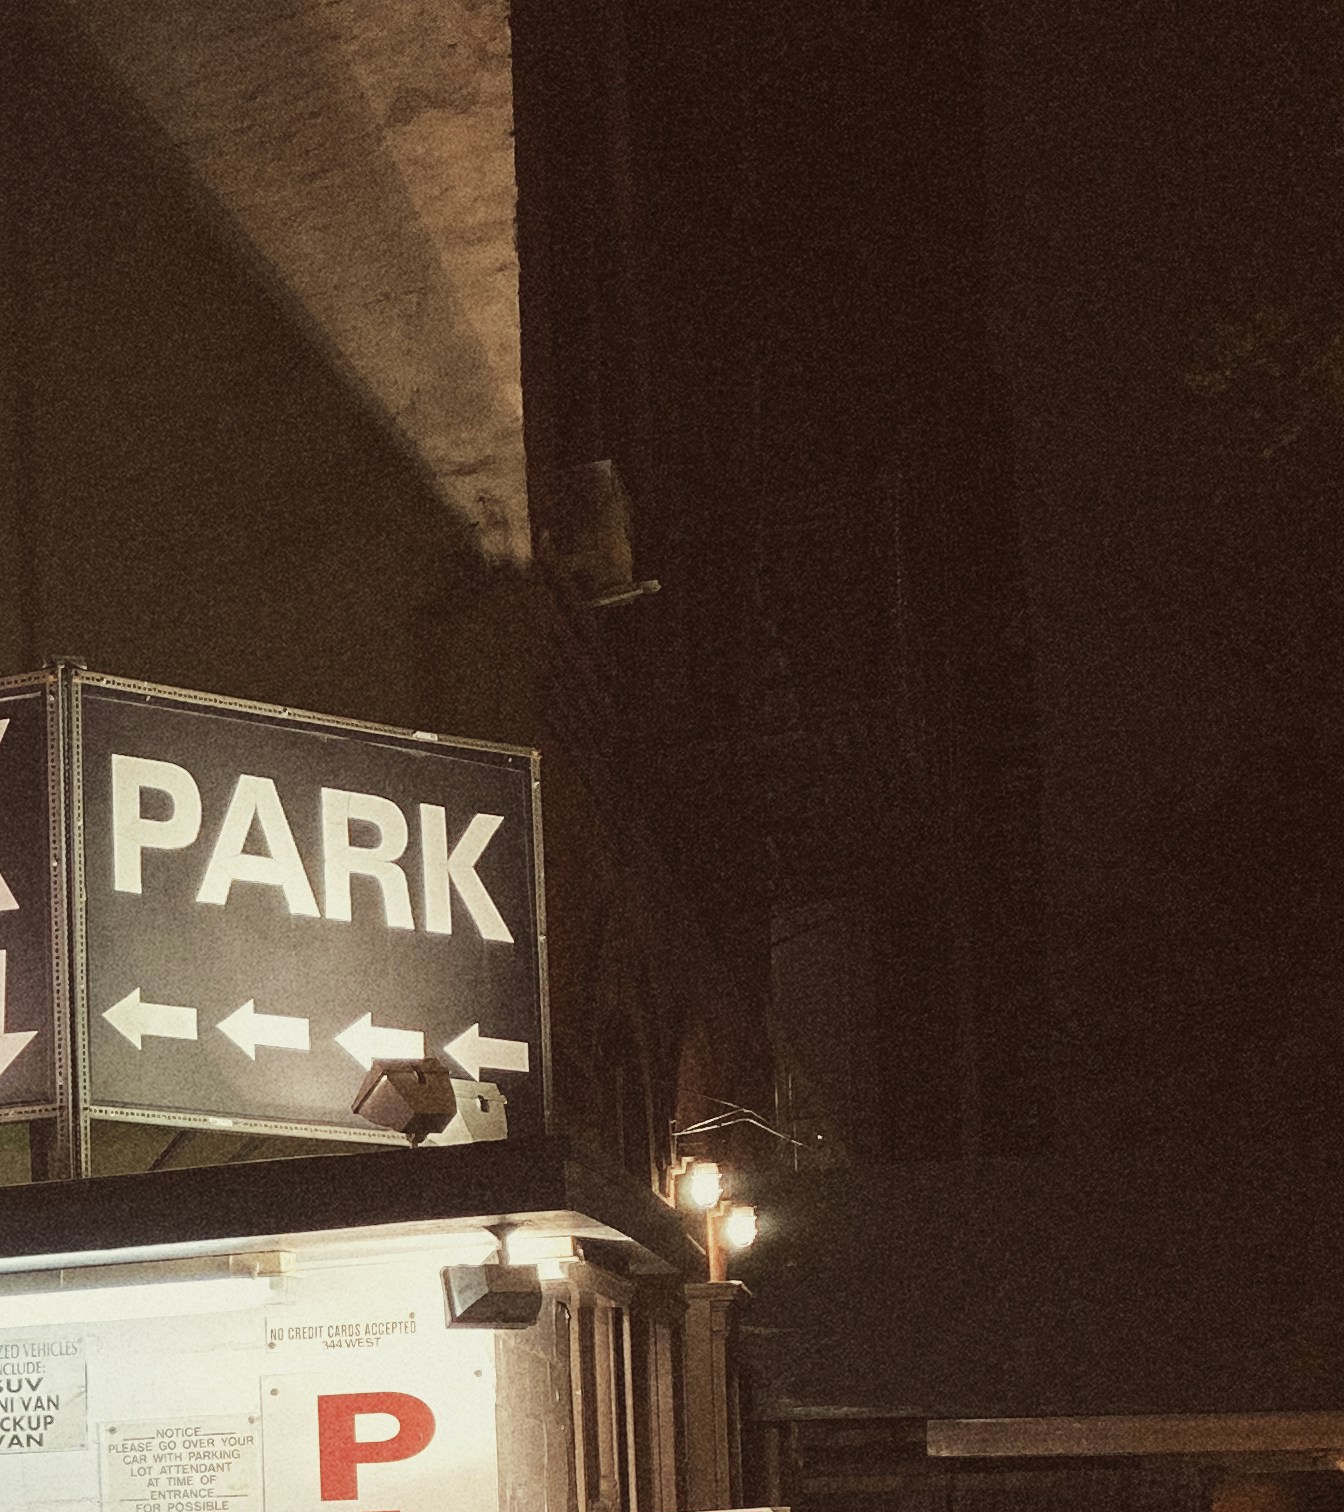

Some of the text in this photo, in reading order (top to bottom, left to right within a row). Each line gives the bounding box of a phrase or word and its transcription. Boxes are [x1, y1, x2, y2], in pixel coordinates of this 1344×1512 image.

[111, 753, 514, 944] PARK
[270, 1320, 416, 1341] NO CREDIT CARDS ACCEPTED
[23, 1340, 78, 1358] VEHICLES
[322, 1337, 381, 1350] 344 WEST
[20, 1395, 60, 1412] VAN
[156, 1427, 202, 1439] NOTICE
[108, 1435, 254, 1454] PLEASE GO OVER YOUR
[122, 1449, 241, 1465] CAR WITH PARKING
[130, 1462, 232, 1477] LOT ATTENDANT
[147, 1475, 217, 1488] AT TIME OF
[150, 1488, 215, 1500] ENTRANCE
[167, 1501, 229, 1512] POSSIBLE
